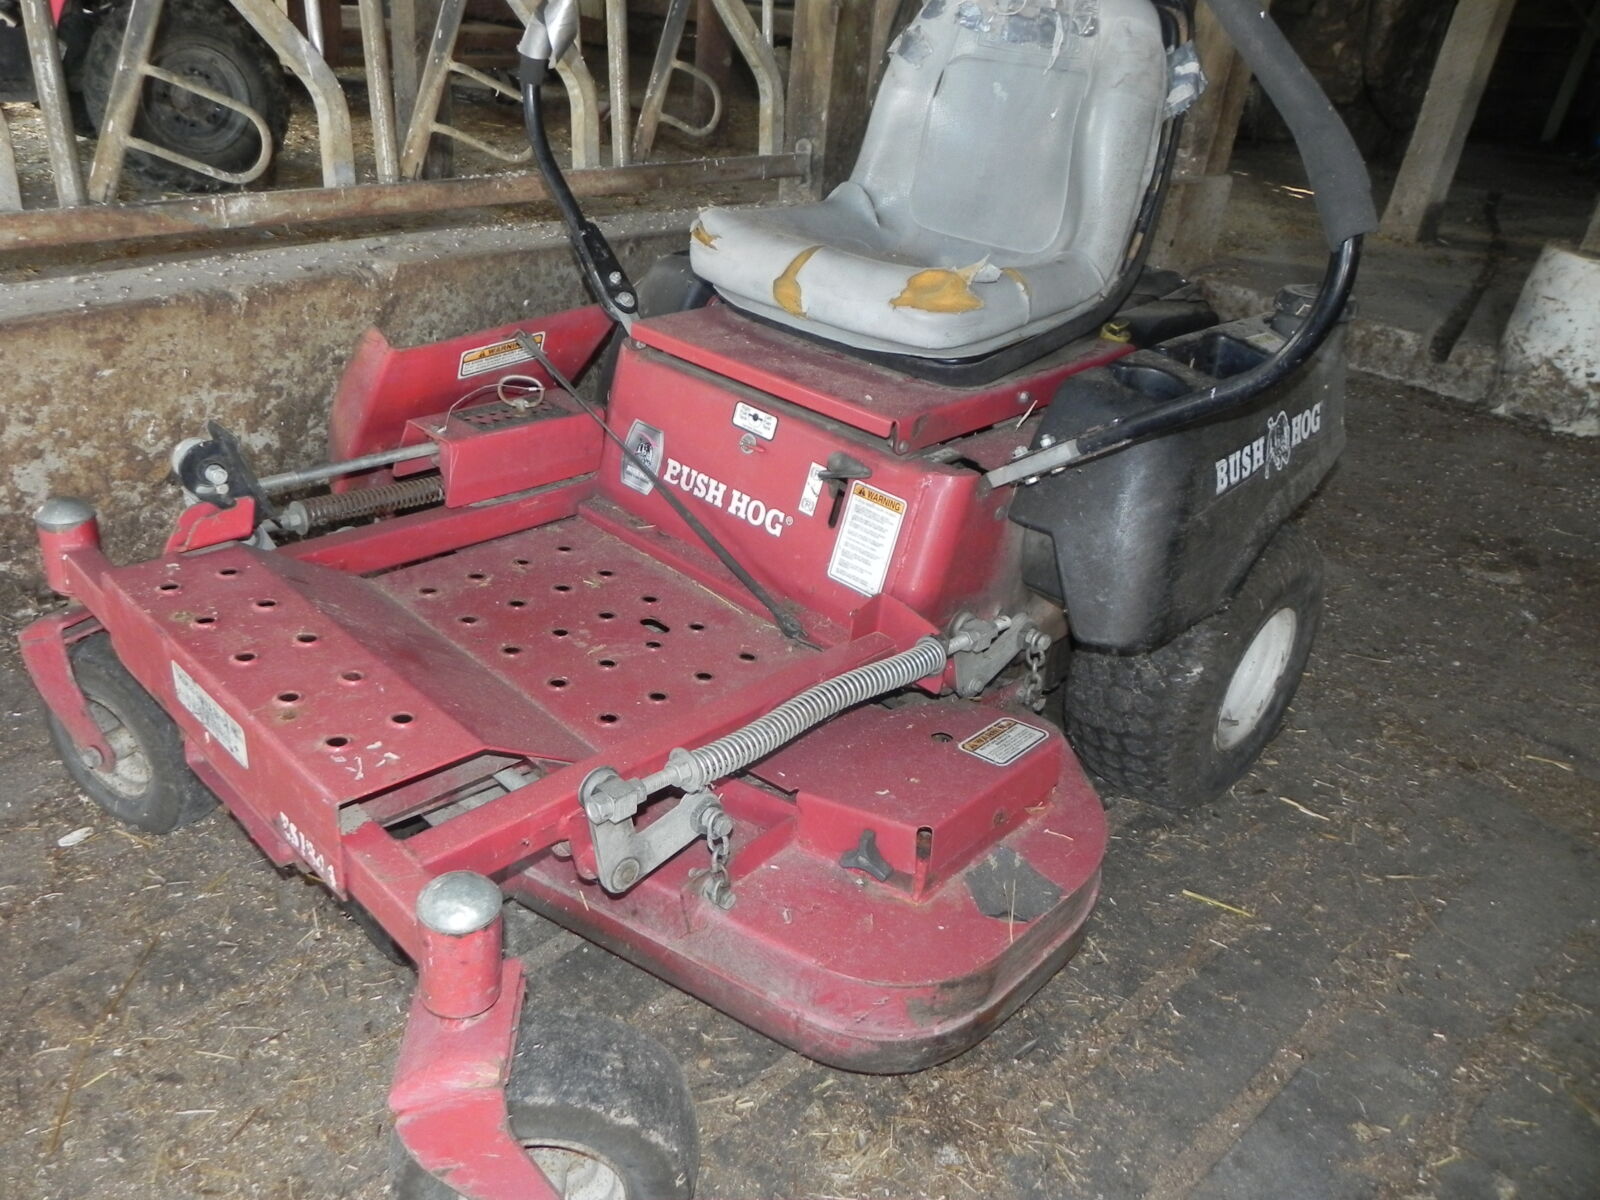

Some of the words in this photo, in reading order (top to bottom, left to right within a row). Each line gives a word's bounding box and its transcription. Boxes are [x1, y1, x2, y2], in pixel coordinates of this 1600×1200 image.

[1215, 436, 1265, 495] BUSH
[1291, 400, 1322, 448] HOG
[663, 457, 727, 508] BUSH
[867, 490, 901, 512] WARNING
